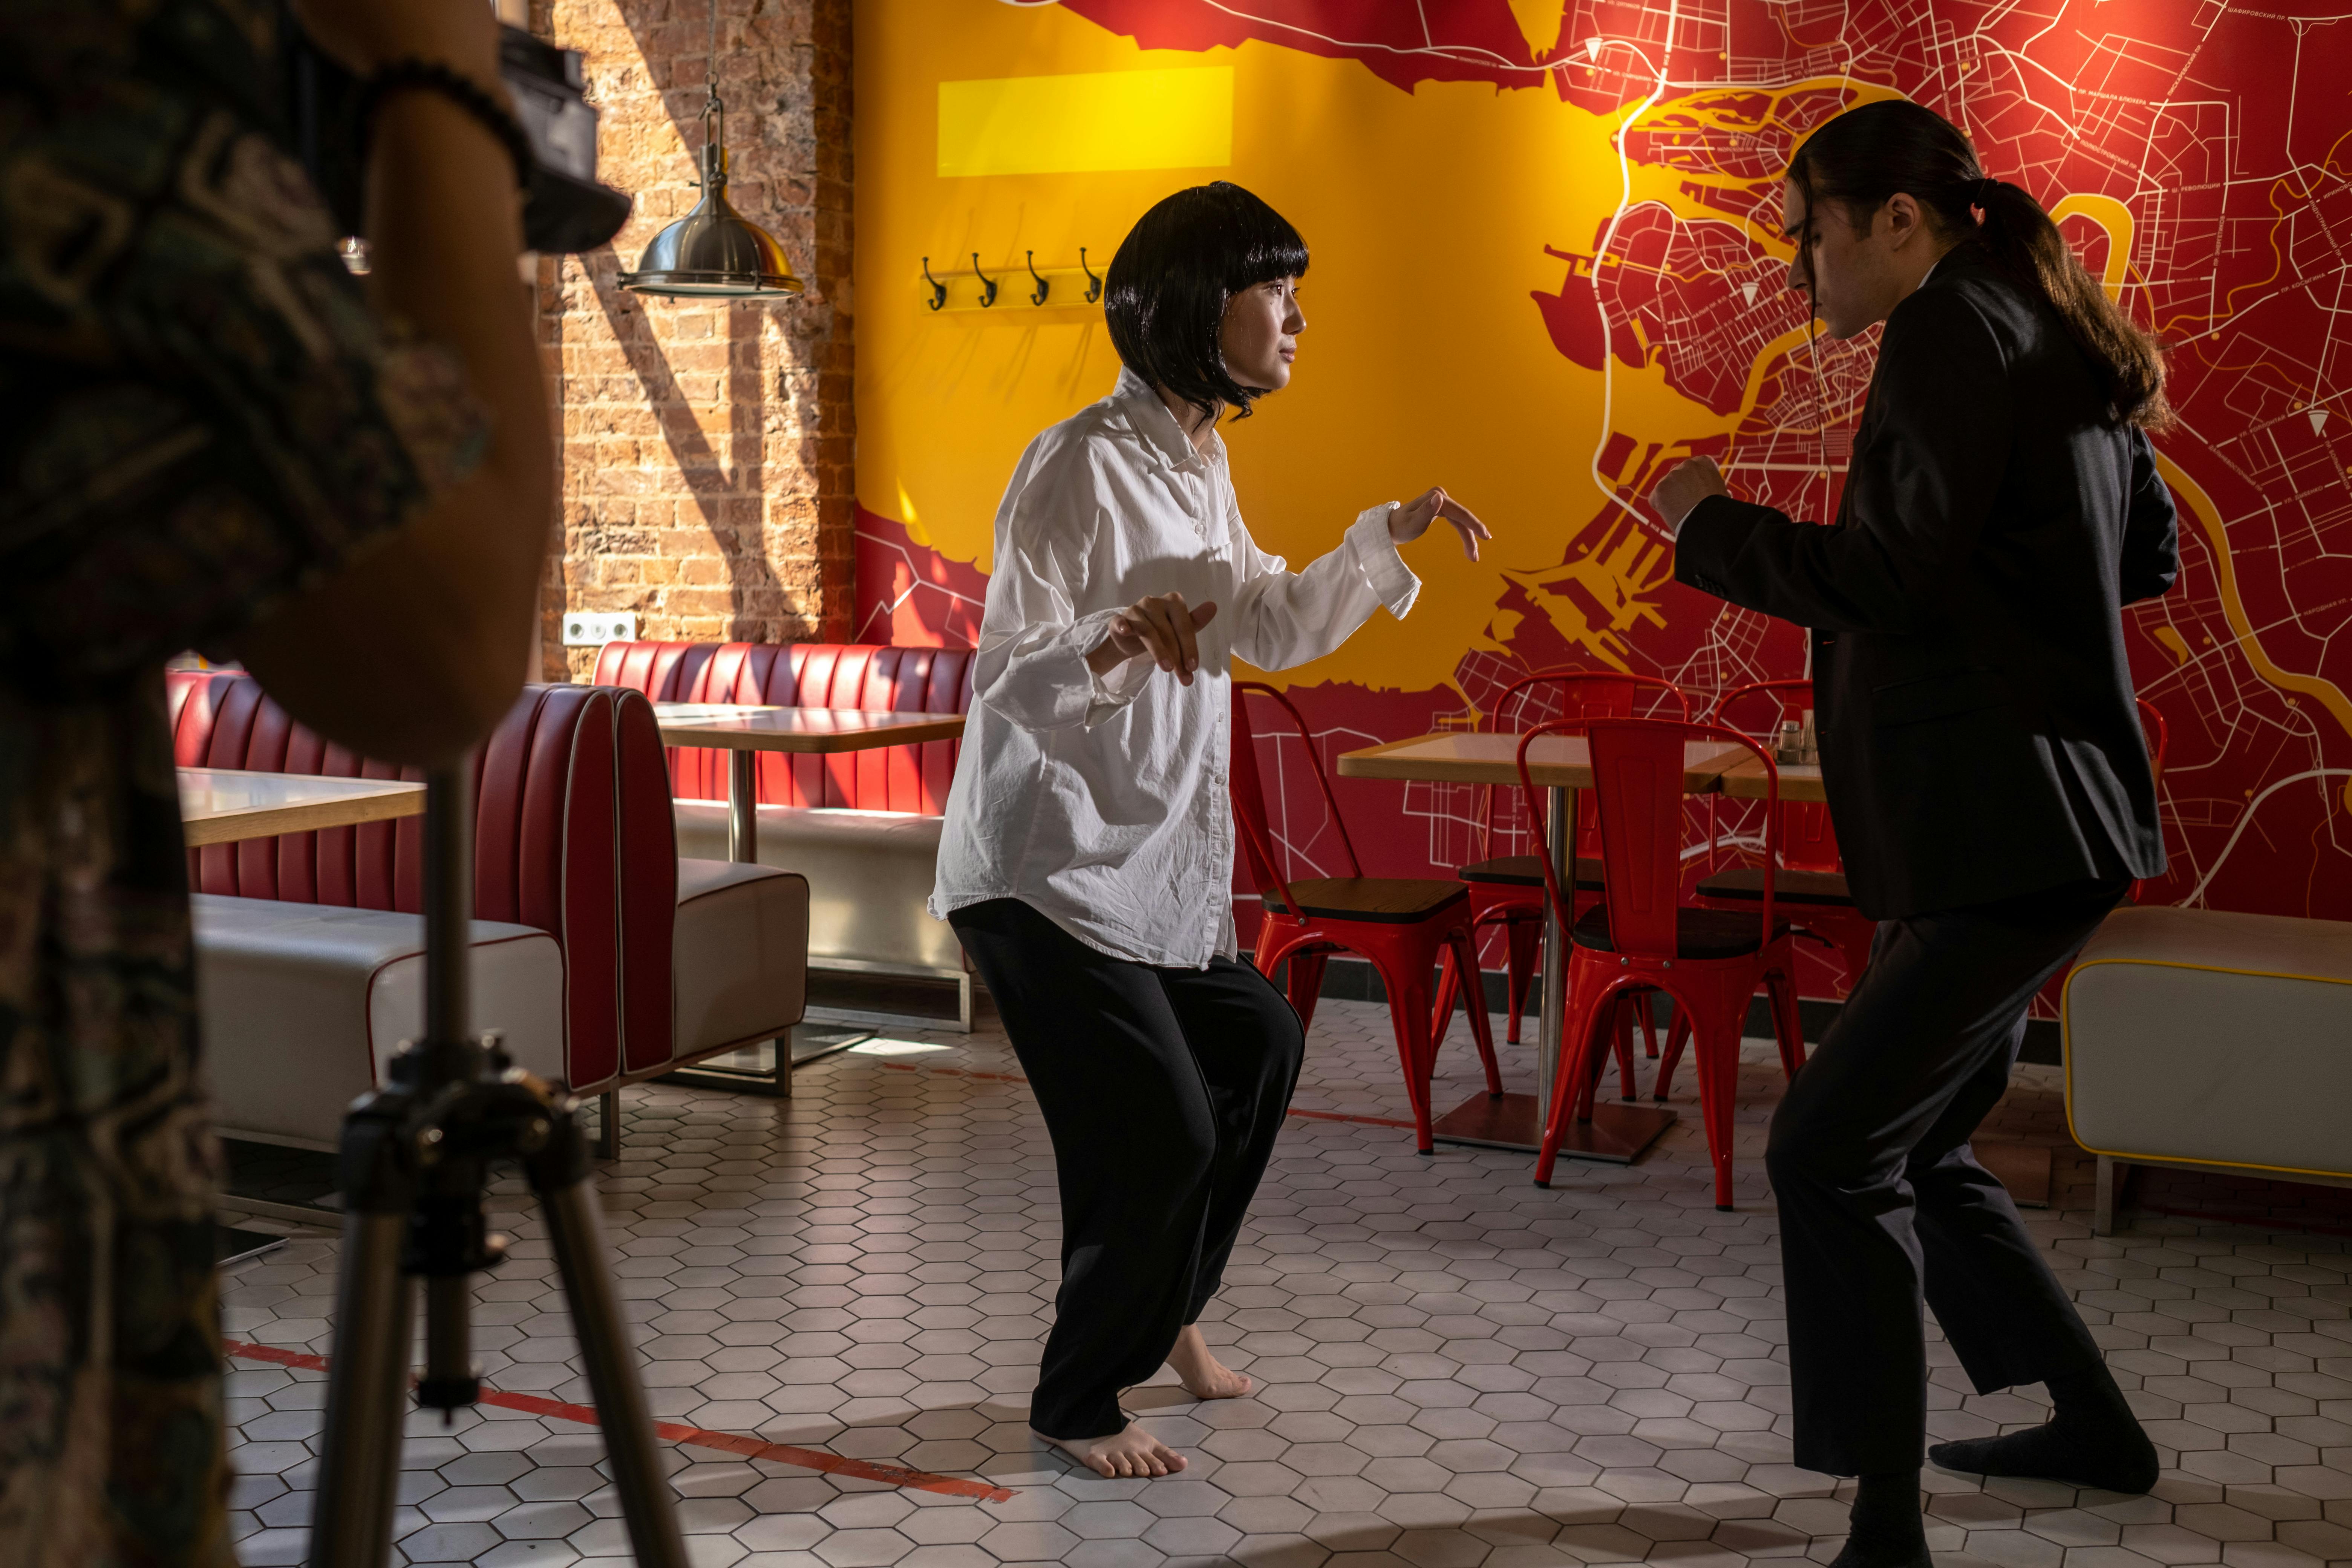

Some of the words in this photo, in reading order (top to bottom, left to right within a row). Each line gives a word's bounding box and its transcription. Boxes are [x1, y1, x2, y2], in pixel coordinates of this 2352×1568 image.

[2228, 7, 2275, 19] ШАФИРОВСКИЙ
[2167, 53, 2197, 96] ПИСКАРЕВСКИЙ
[2088, 90, 2117, 100] МАРШАЛА
[2119, 95, 2146, 105] БЛЮХЕРА
[2080, 139, 2129, 166] ПОЛЮСТРОВСКИЙ
[2181, 182, 2220, 192] РЕВОЛЮЦИИ
[2309, 199, 2338, 249] ИНДУСТРИАЛЬНЫЙ
[2292, 273, 2326, 289] КОСЫГИНА
[2250, 414, 2286, 433] КОЛЛОНТАЙ
[2208, 444, 2256, 486] ДАЛЬНЕВОСТОЧНЫЙ
[2329, 449, 2351, 490] БОЛЬШЕВИКОВ
[2294, 485, 2323, 501] ДЫБЕНКО
[2303, 600, 2337, 617] НАРОДНАЯ
